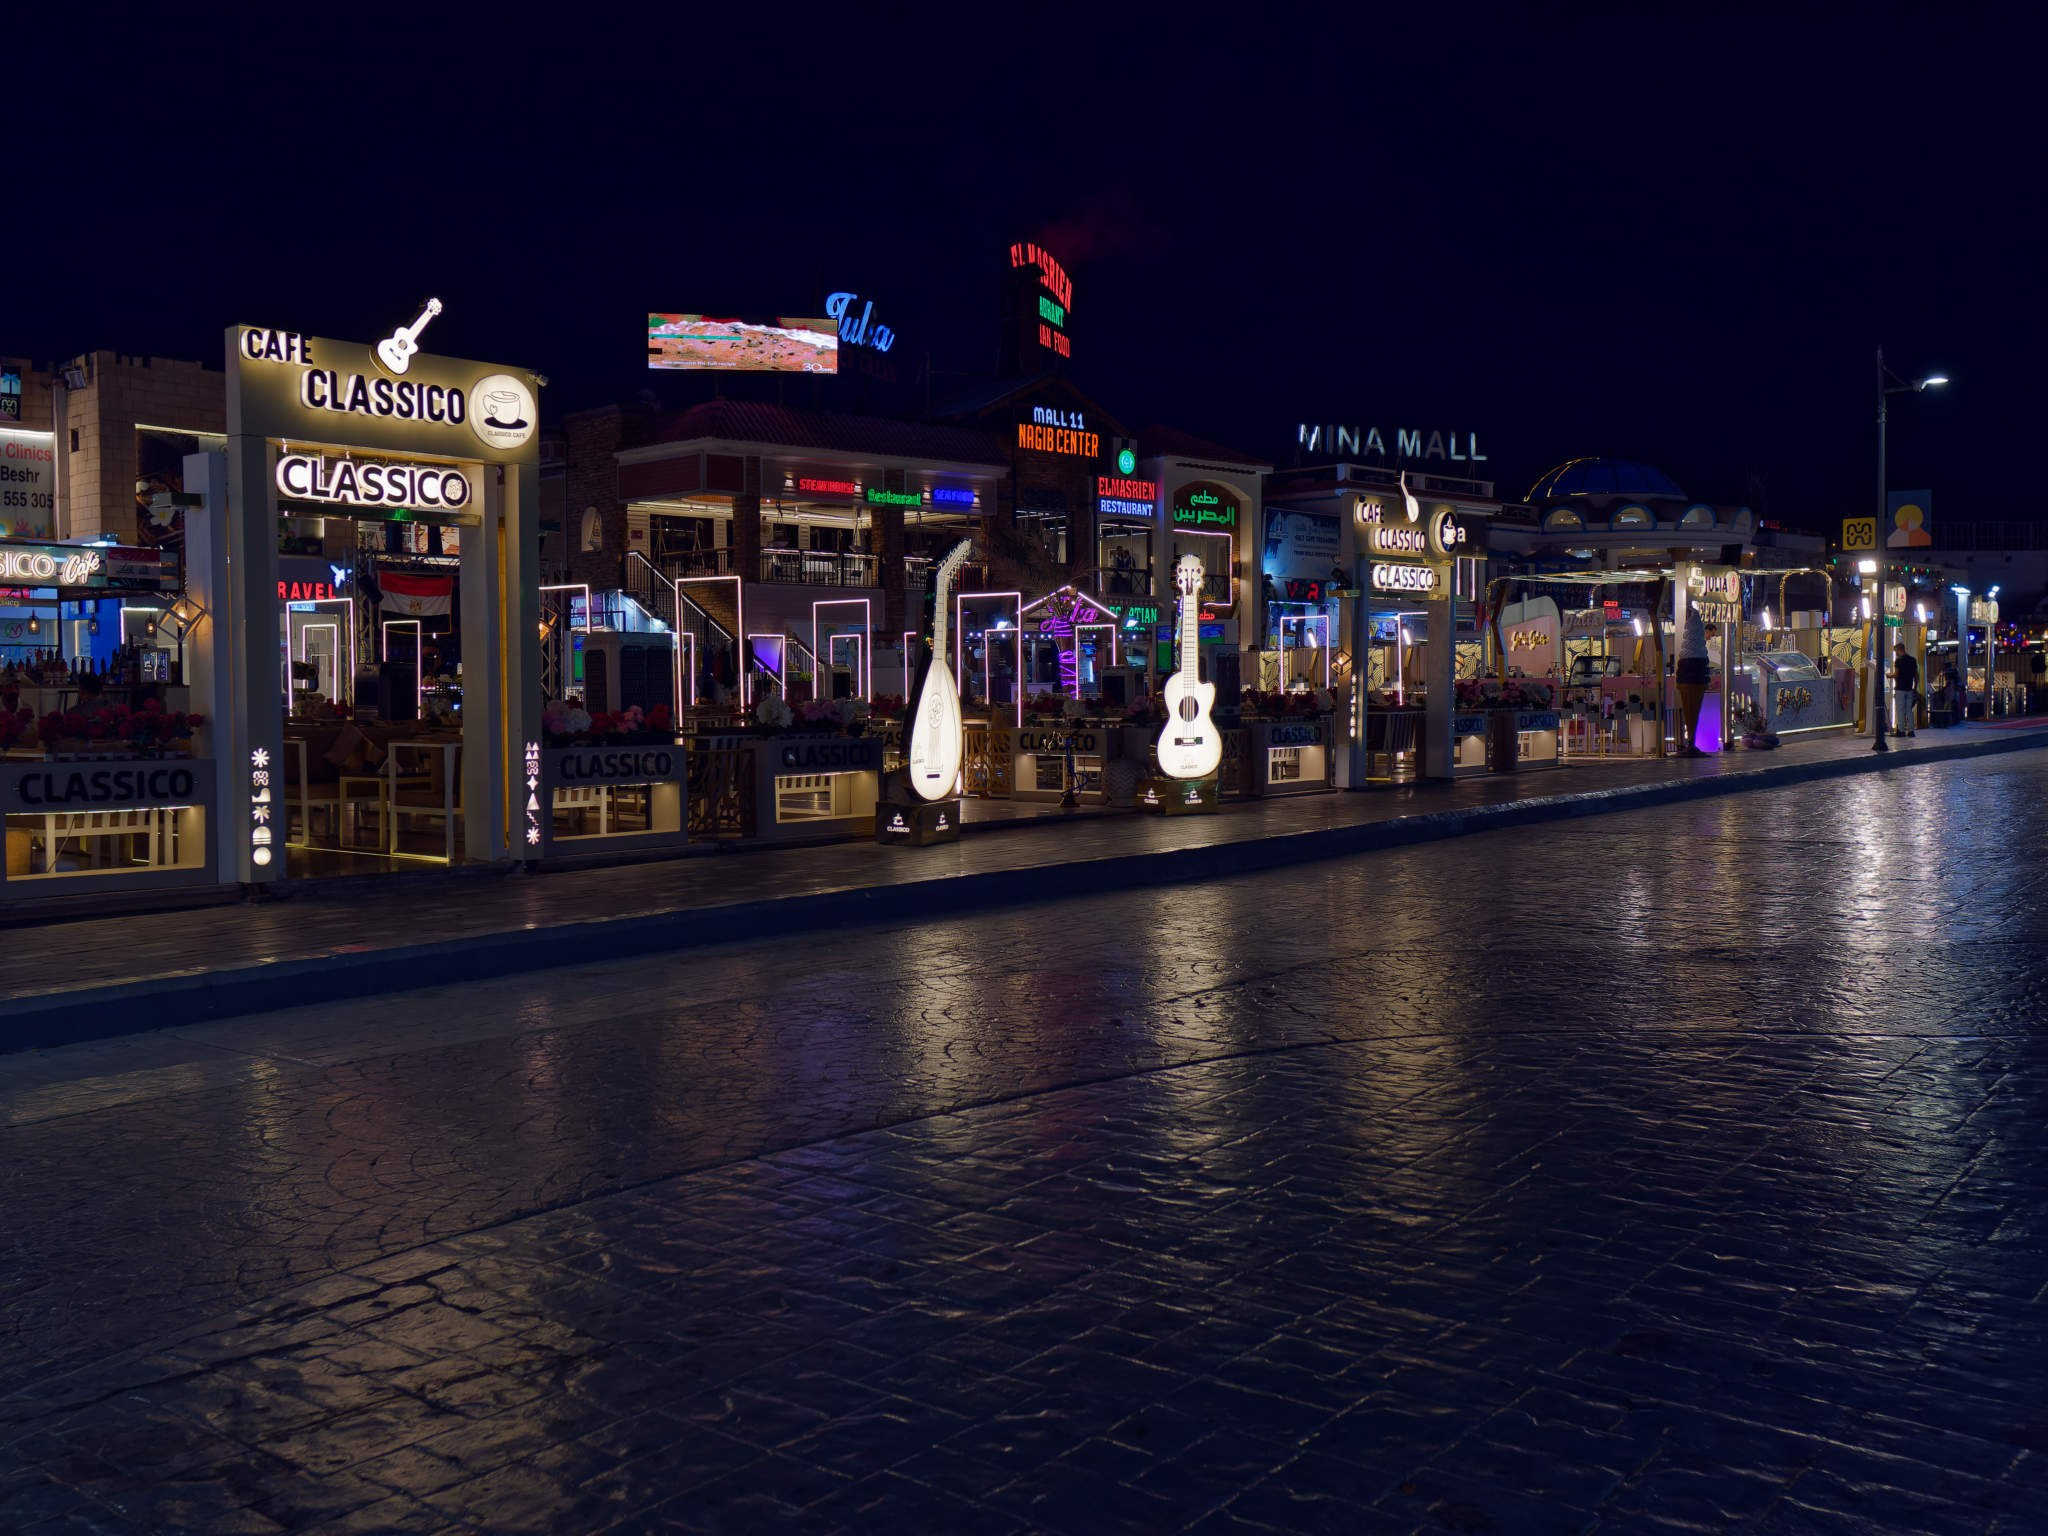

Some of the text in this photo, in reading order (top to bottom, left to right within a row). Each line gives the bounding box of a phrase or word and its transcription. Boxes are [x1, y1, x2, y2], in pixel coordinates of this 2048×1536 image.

[243, 329, 313, 365] CAFE
[1054, 330, 1070, 358] FOOD
[303, 369, 465, 425] CLASSICO
[1034, 406, 1067, 427] MALL
[5, 442, 53, 462] Clinics
[1019, 423, 1099, 458] NAGIB CENTER
[1299, 423, 1488, 461] MINA MALL
[0, 465, 40, 484] Beshr
[278, 455, 469, 509] CLASSICO
[3, 490, 54, 509] 555 305
[1100, 499, 1153, 517] RESTAURANT
[1190, 489, 1219, 507] مطعم
[1173, 504, 1236, 527] المصريين
[1360, 503, 1385, 524] CAFE
[1378, 528, 1426, 552] CLASSICO
[63, 551, 101, 585] Café
[1377, 566, 1435, 590] CLASSICO
[1271, 726, 1322, 743] CLASSICO
[559, 751, 672, 780] CLASSICO
[782, 743, 872, 768] CLASSICO
[19, 768, 194, 804] CLASSICO
